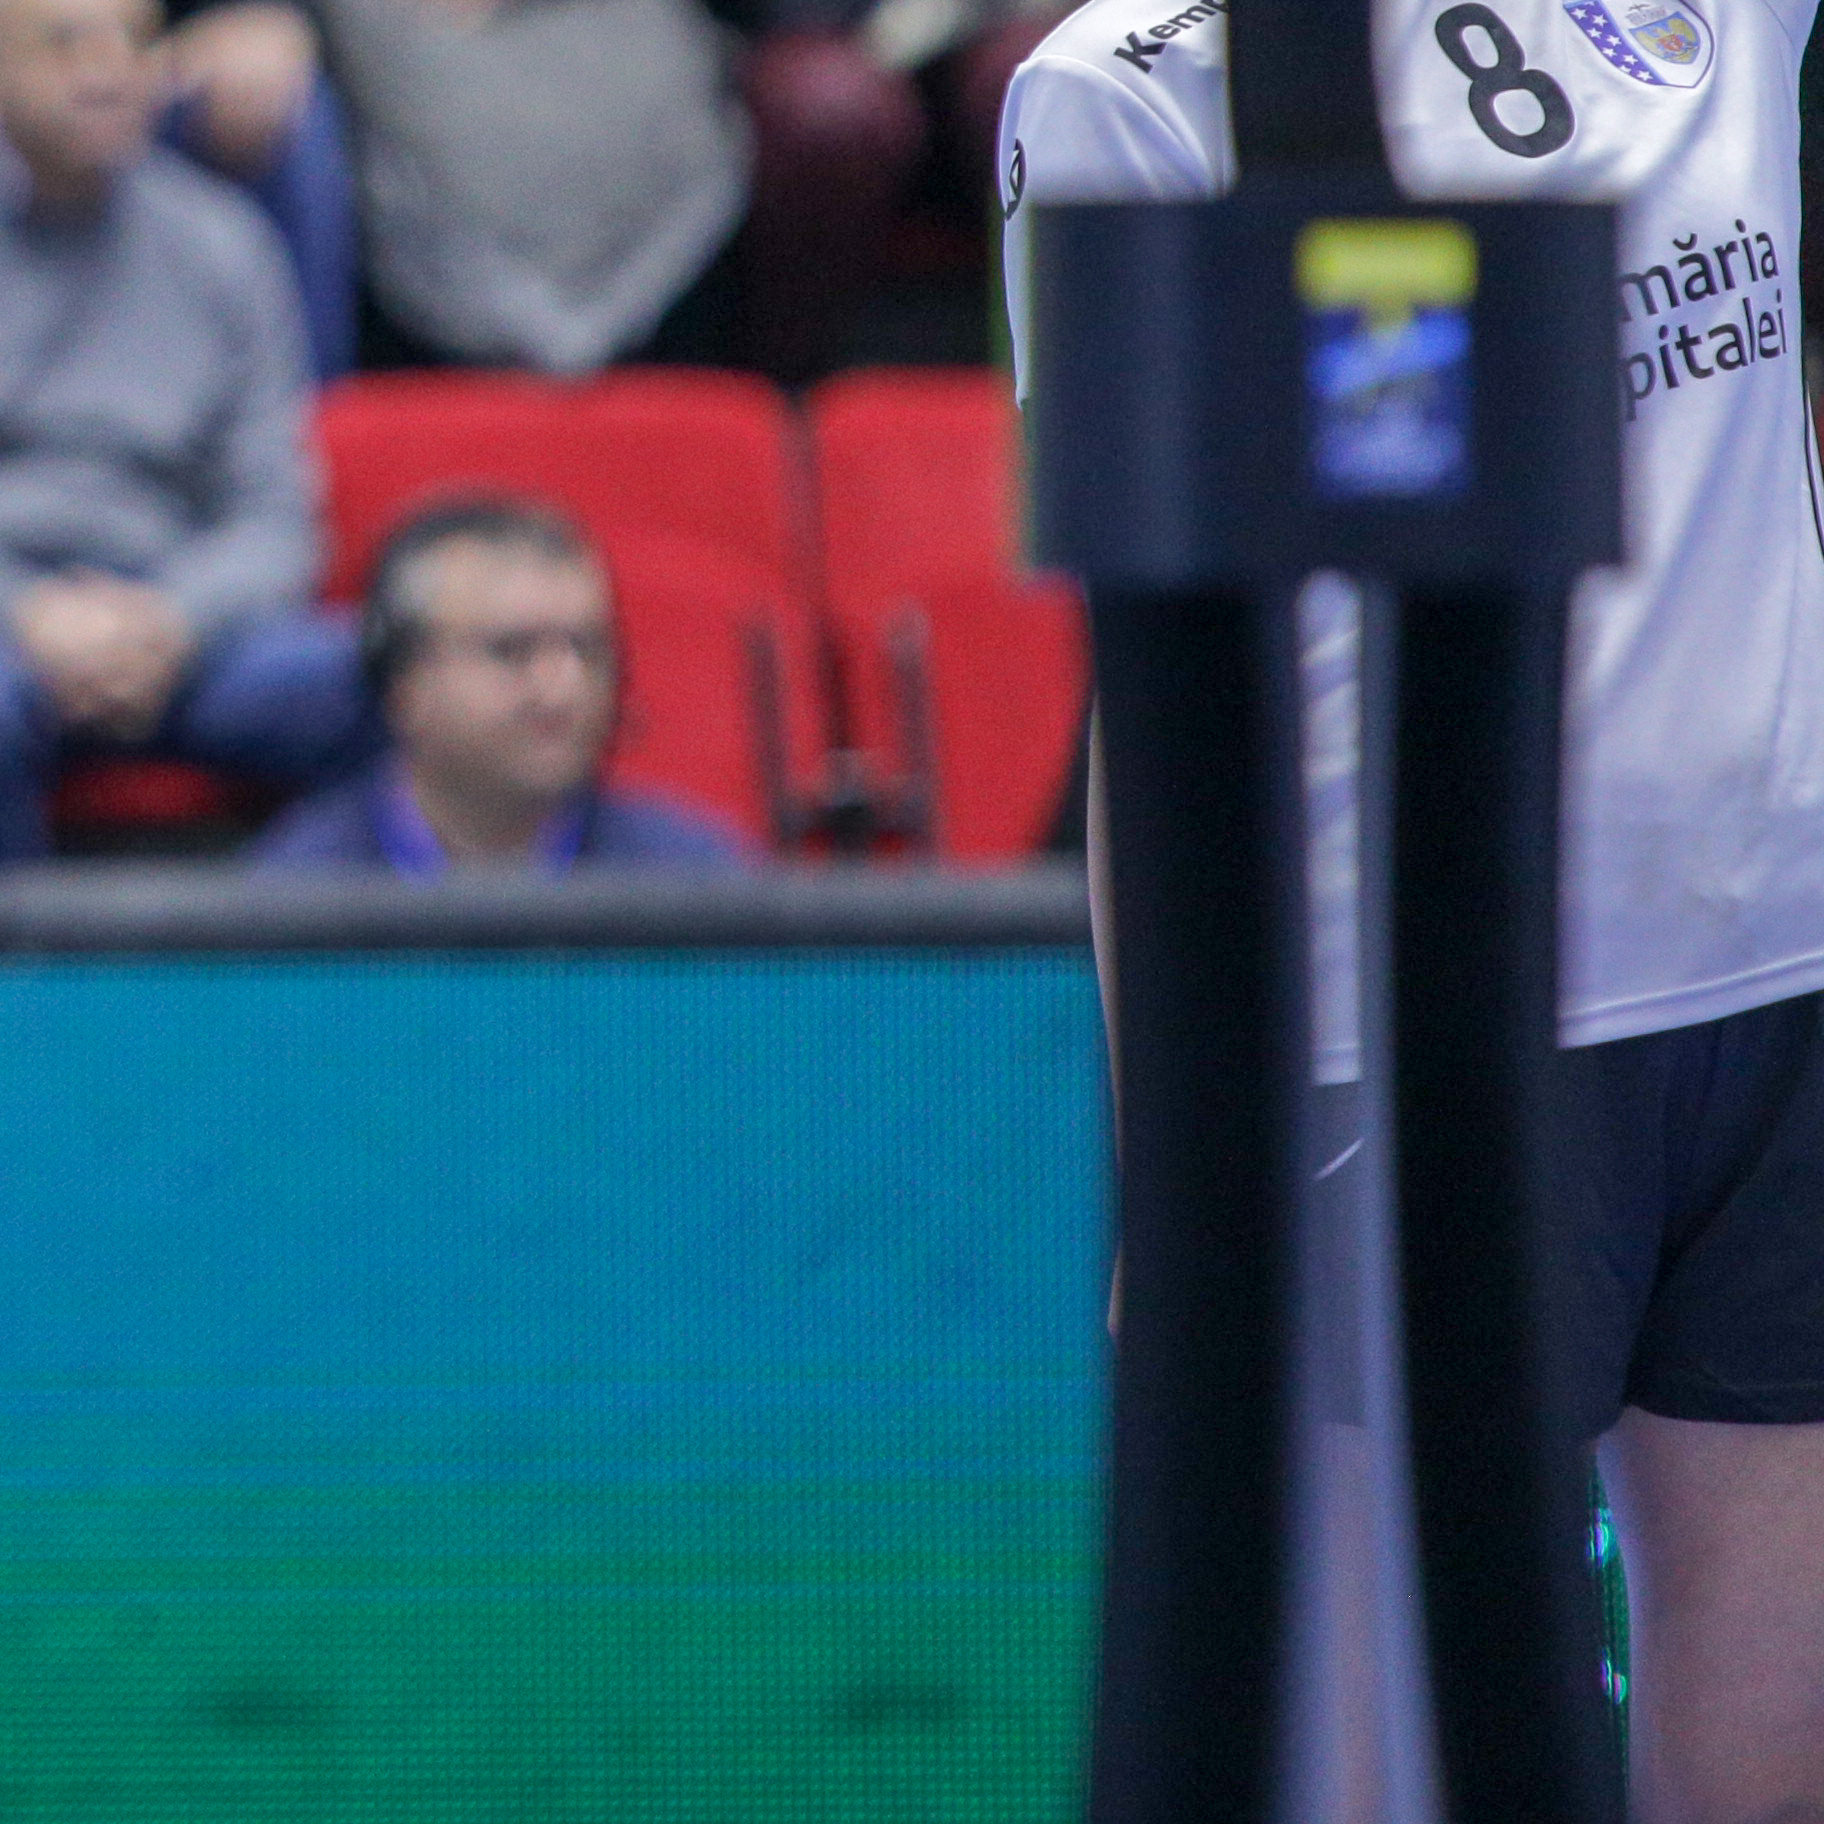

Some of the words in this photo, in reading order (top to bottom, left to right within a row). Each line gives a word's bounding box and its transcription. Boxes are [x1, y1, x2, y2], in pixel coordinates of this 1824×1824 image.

[1434, 2, 1576, 159] 8
[1618, 218, 1779, 323] măria
[1622, 288, 1788, 422] pitalei
